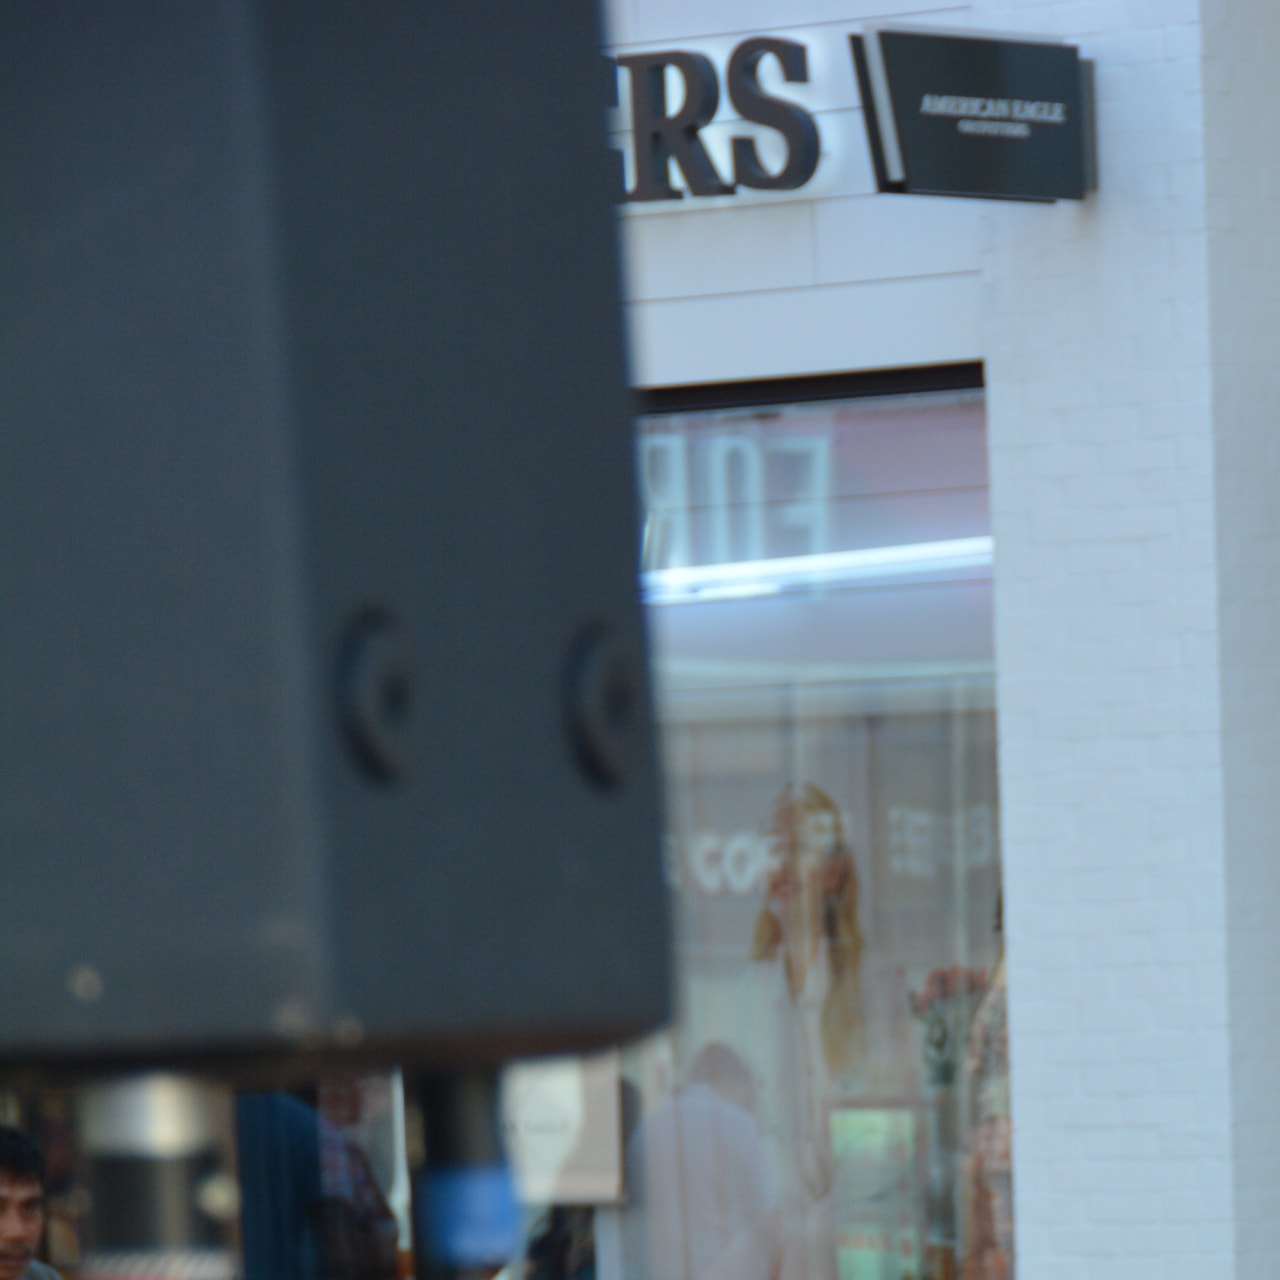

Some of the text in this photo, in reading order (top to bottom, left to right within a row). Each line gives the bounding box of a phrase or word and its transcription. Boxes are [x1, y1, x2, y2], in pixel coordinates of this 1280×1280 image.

[606, 36, 822, 203] RS
[920, 94, 1066, 124] AMERICAN EAGLE
